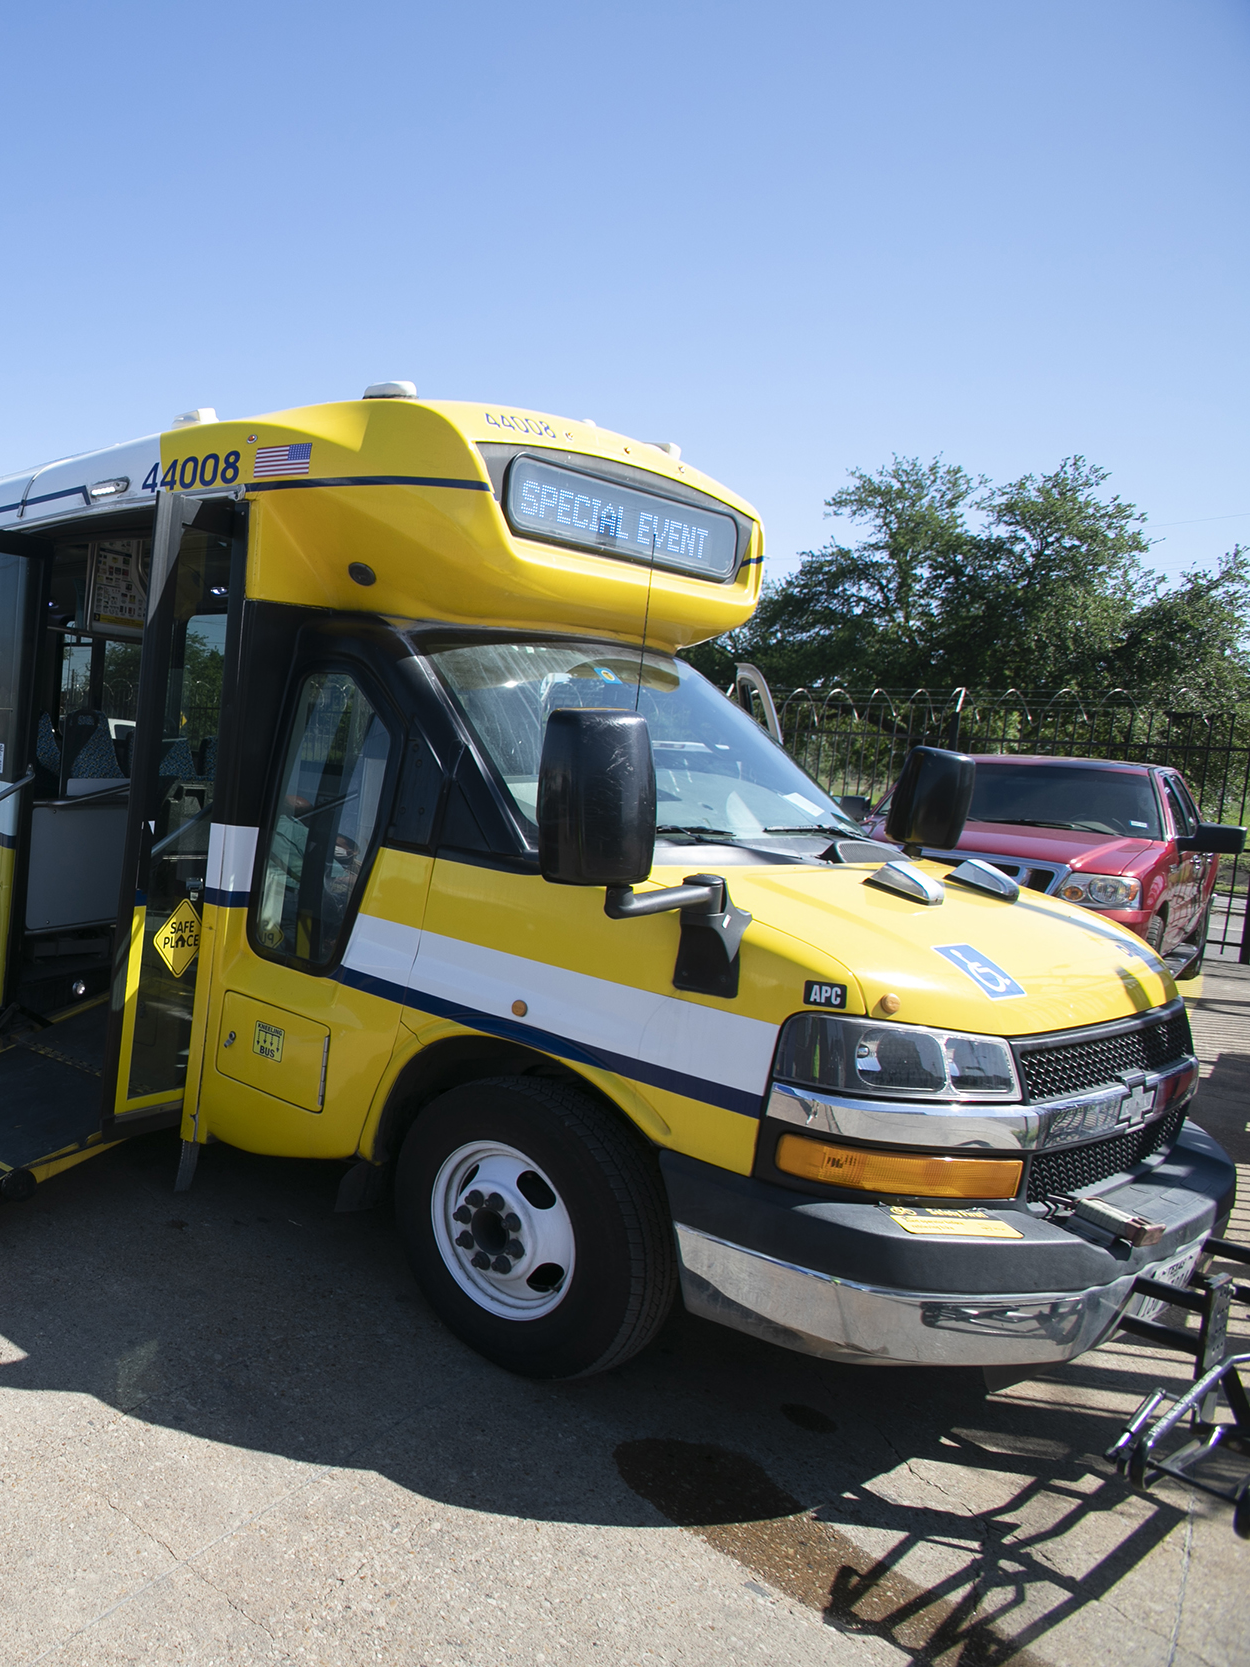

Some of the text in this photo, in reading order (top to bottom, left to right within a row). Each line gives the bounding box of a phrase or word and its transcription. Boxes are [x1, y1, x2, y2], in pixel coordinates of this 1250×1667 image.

[484, 412, 557, 439] 44008
[141, 450, 241, 493] 44008
[520, 480, 709, 559] SPECIAL EVENT
[170, 920, 195, 934] SAFE
[809, 984, 842, 1005] APC
[257, 1023, 283, 1036] KNEELING
[259, 1044, 275, 1058] BUS
